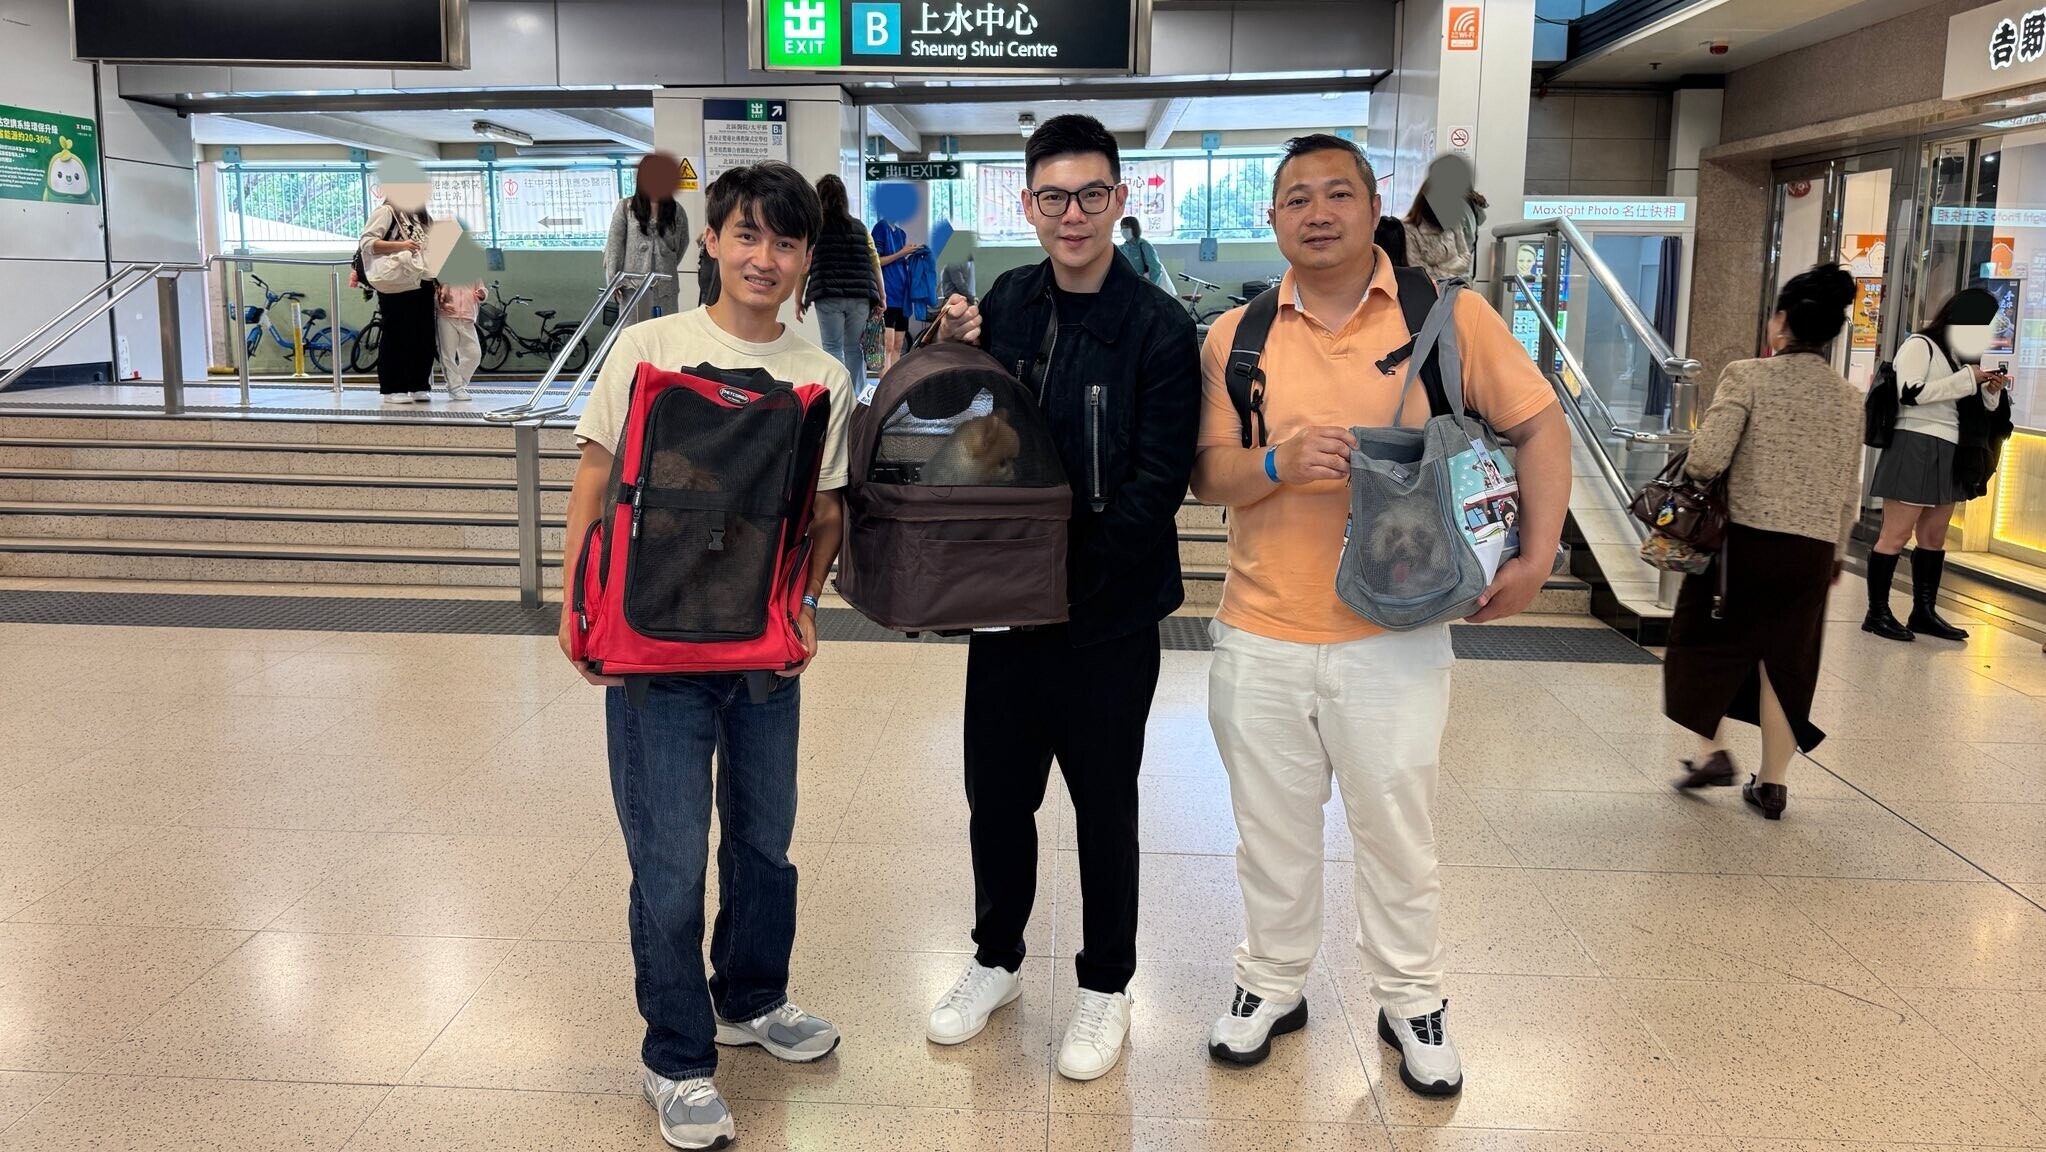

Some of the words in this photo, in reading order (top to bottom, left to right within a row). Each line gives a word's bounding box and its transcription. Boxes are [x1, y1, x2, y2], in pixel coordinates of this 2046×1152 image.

[911, 2, 1038, 36] 上水中心
[867, 11, 888, 46] B
[785, 40, 825, 54] EXIT
[911, 40, 966, 60] Sheung
[971, 41, 1003, 57] Shui
[1007, 41, 1057, 57] Centre
[80, 124, 92, 132] MTR
[886, 164, 909, 177] 出口
[911, 164, 943, 177] EXIT
[1532, 205, 1585, 217] MaxSight
[1588, 205, 1619, 216] Photo
[1622, 205, 1677, 218] 名仕快相
